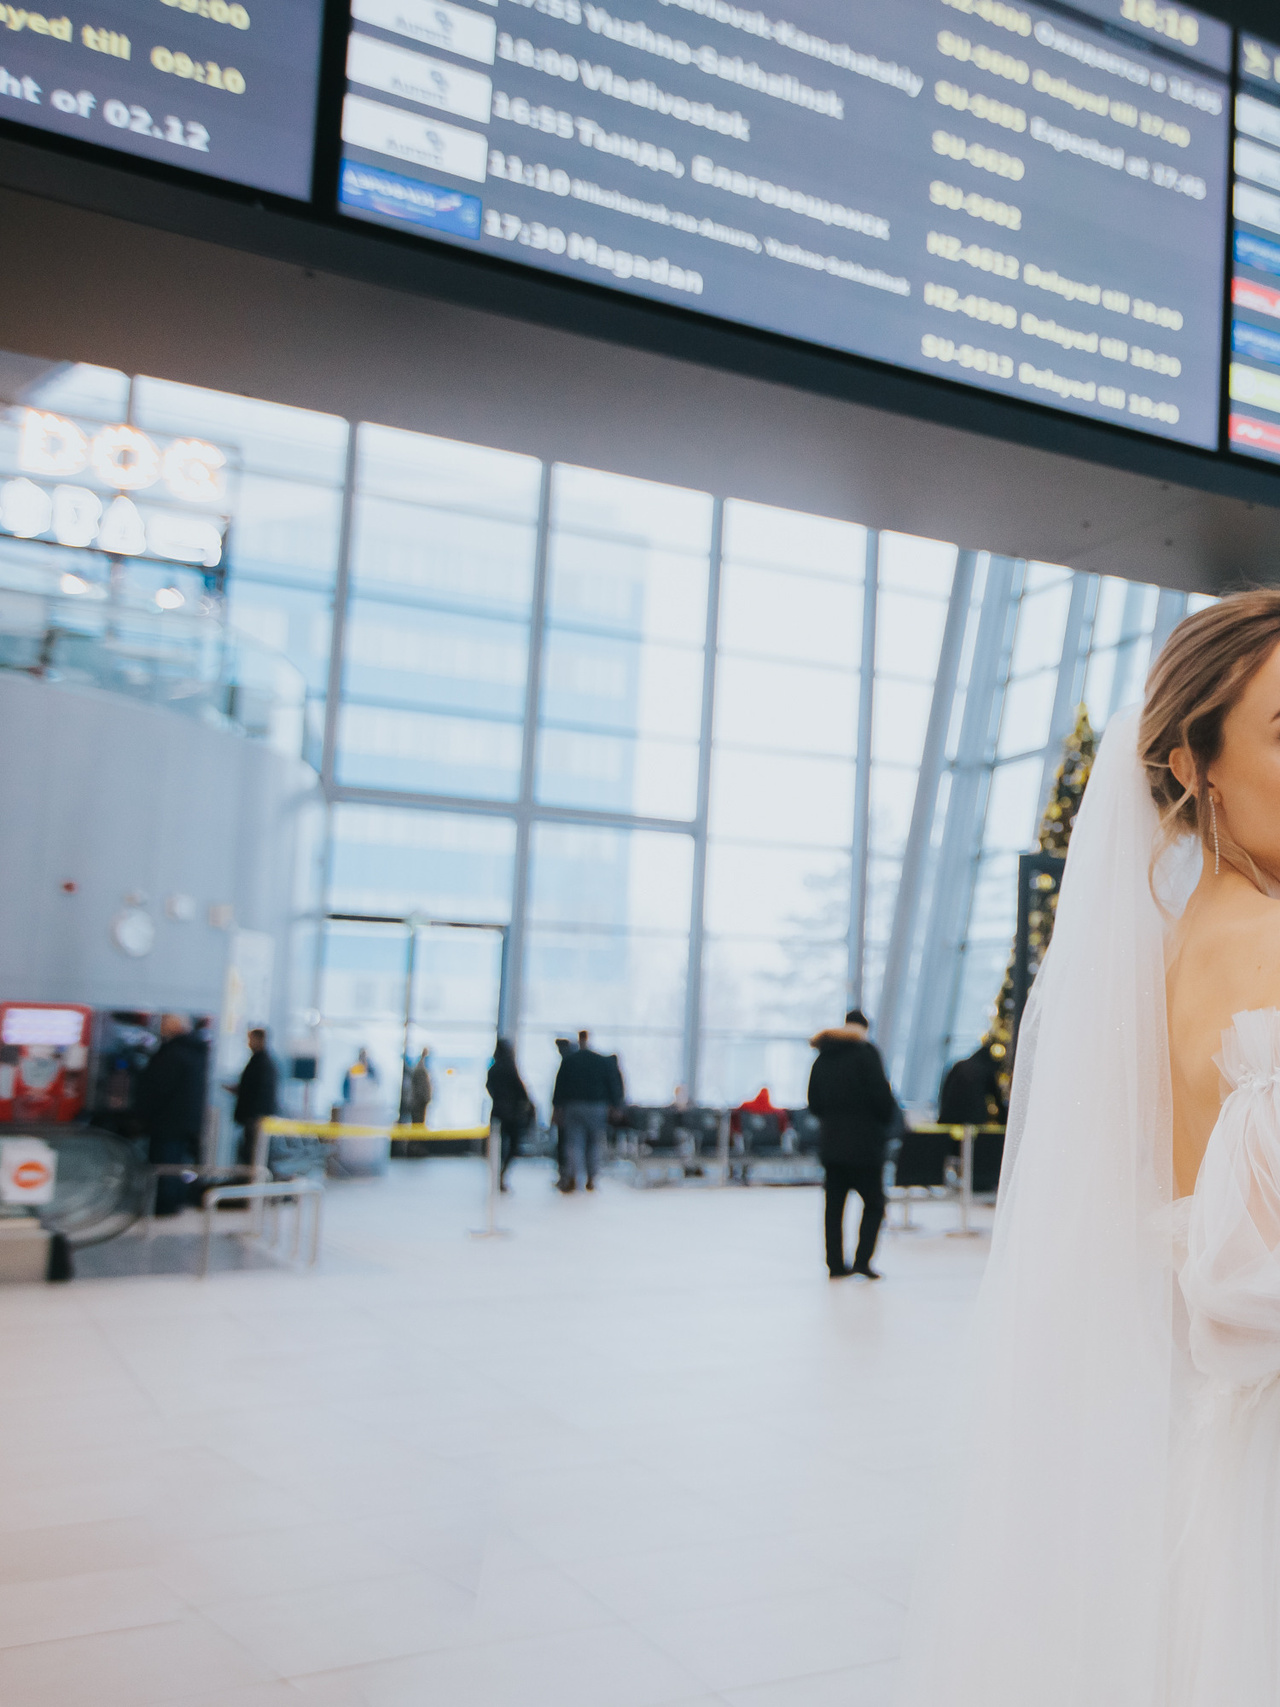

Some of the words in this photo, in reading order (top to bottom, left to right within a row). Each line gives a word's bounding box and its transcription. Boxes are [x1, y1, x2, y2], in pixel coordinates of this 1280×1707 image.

[159, 0, 251, 31] 9:00
[81, 23, 132, 61] till
[150, 45, 247, 95] 09:10
[50, 88, 98, 119] of
[103, 98, 212, 153] 02.12
[567, 231, 704, 296] Magadan
